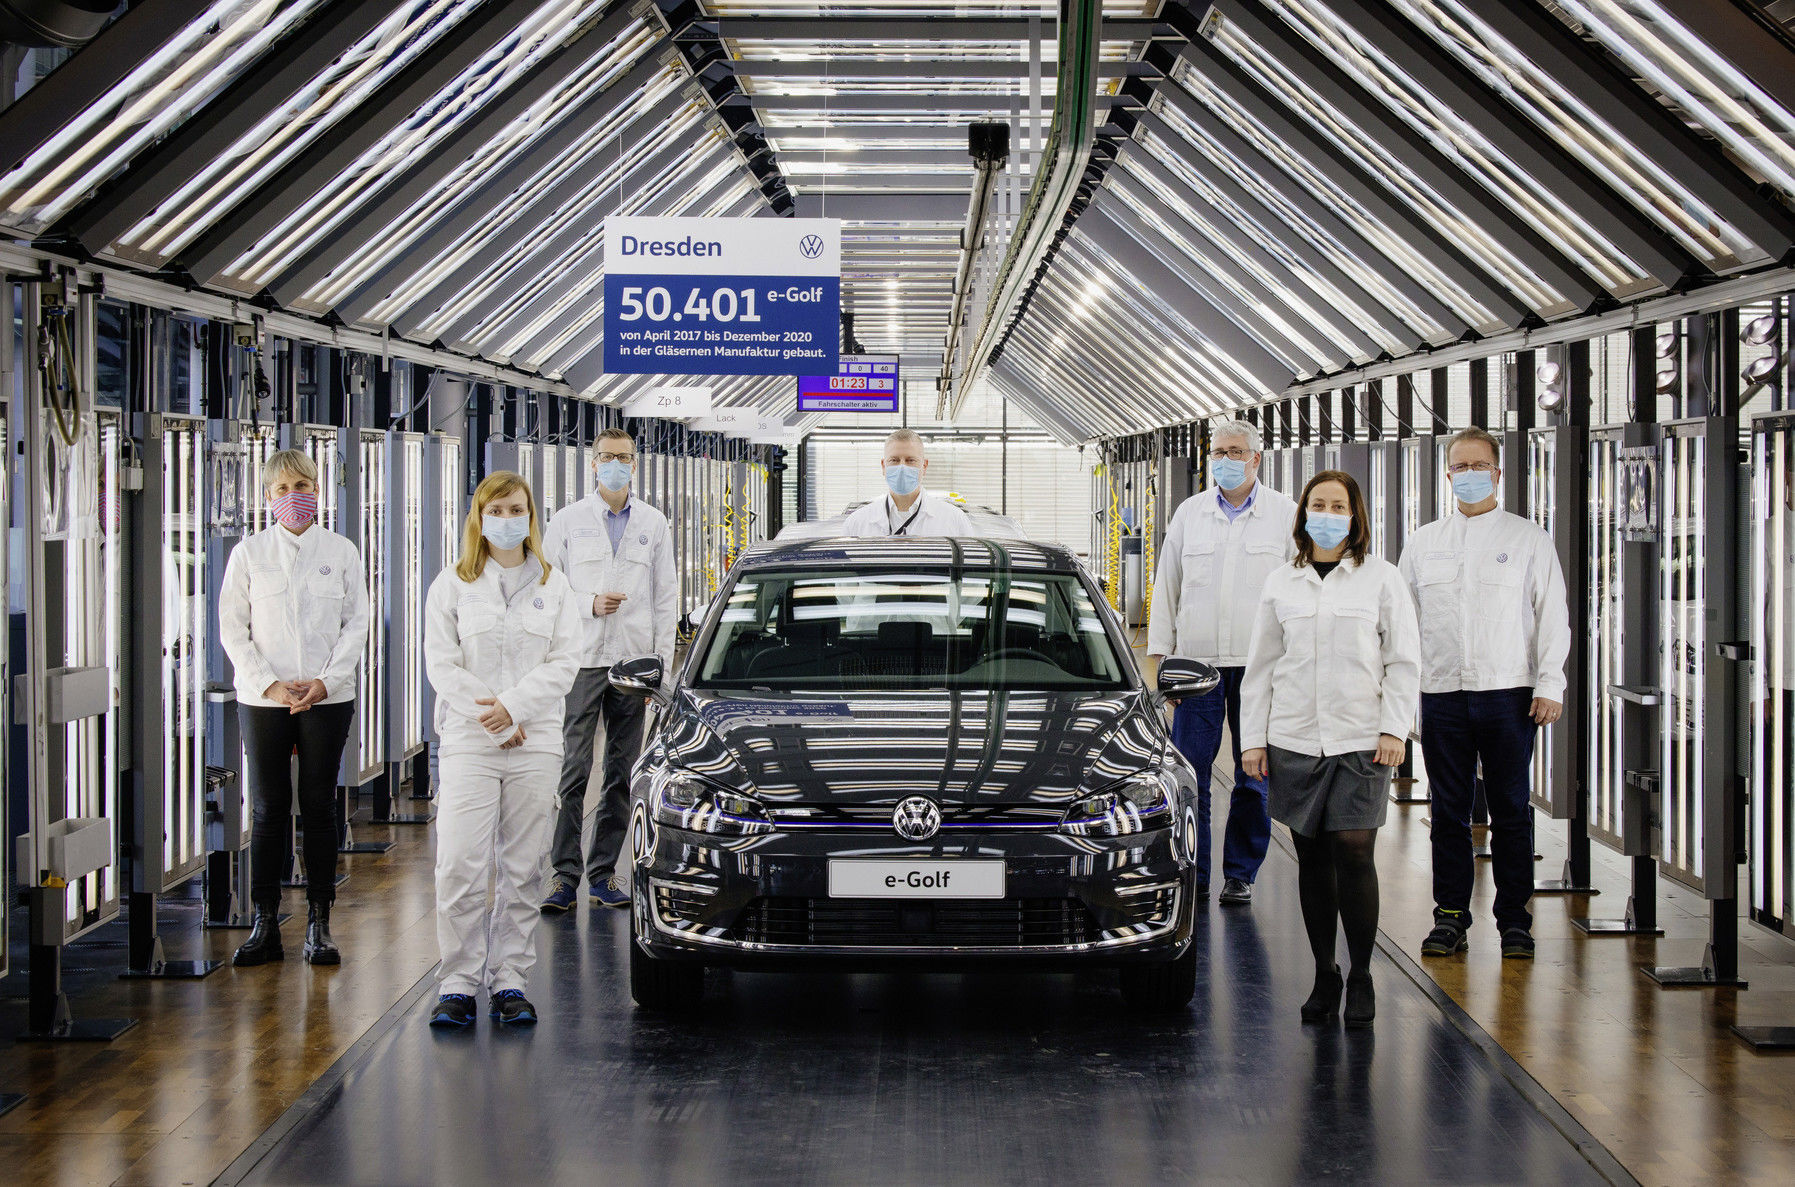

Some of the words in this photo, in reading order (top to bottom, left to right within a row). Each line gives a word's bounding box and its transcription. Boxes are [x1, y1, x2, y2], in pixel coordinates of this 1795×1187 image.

[621, 235, 722, 257] Dresden
[619, 286, 761, 323] 50.401
[767, 286, 823, 303] e-Golf
[620, 332, 641, 340] von
[643, 330, 671, 343] April
[673, 330, 702, 341] 2017
[704, 330, 721, 341] bis
[723, 330, 781, 342] Dezember
[783, 331, 813, 342] 2020
[619, 344, 631, 356] in
[632, 344, 653, 356] der
[654, 345, 712, 357] Gläsernen
[714, 346, 781, 357] Manufaktur
[783, 347, 827, 359] gebaut.
[831, 377, 865, 389] 01:23
[878, 379, 884, 389] 3
[657, 396, 672, 407] Zp
[674, 396, 682, 406] 8
[818, 400, 860, 408] Fahrschalter
[716, 414, 737, 423] Lack
[884, 870, 951, 888] e-Golf
